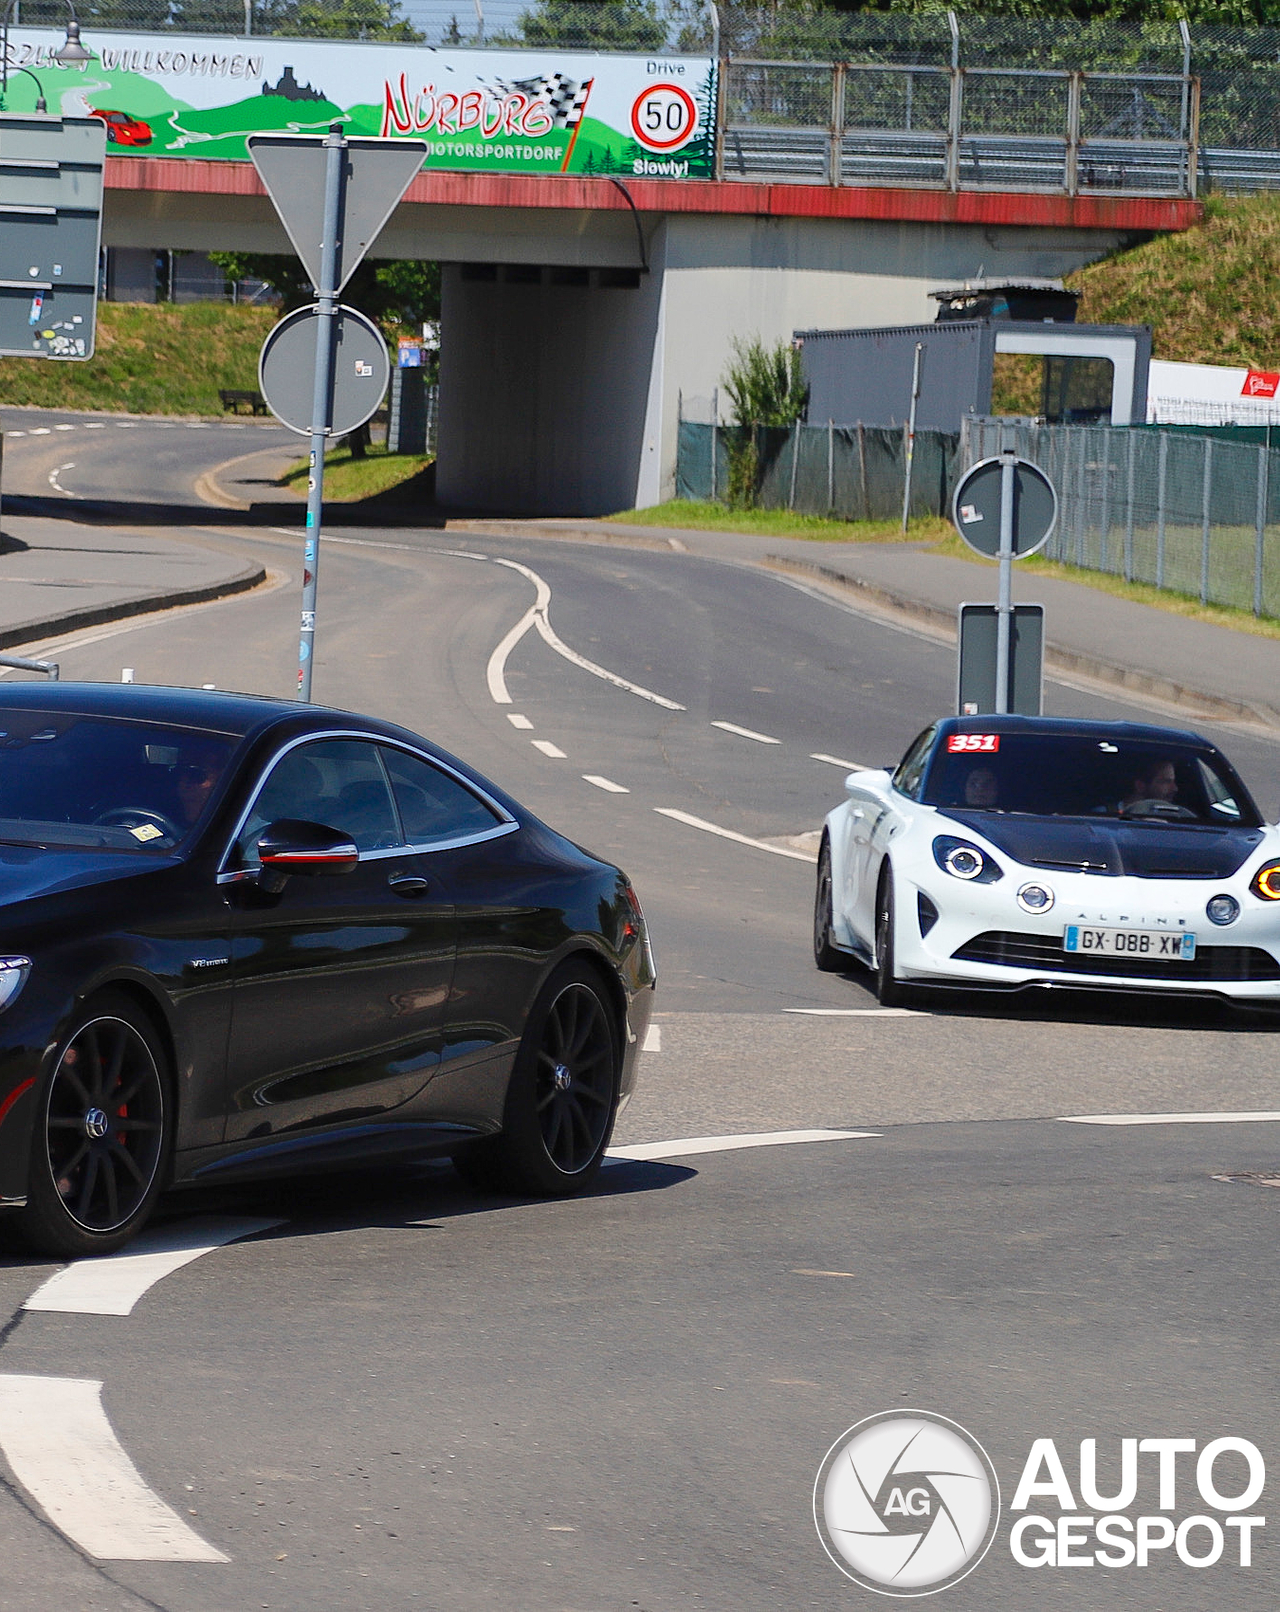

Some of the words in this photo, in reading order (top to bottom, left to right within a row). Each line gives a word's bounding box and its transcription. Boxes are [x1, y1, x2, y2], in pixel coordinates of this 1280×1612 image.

[101, 47, 263, 80] WILLKOMMEN
[646, 61, 686, 75] Drive
[381, 71, 553, 138] NÜRBURG
[646, 101, 683, 131] 50
[632, 158, 689, 179] Slowly!
[948, 734, 996, 751] 351
[1078, 912, 1186, 926] ALPINE
